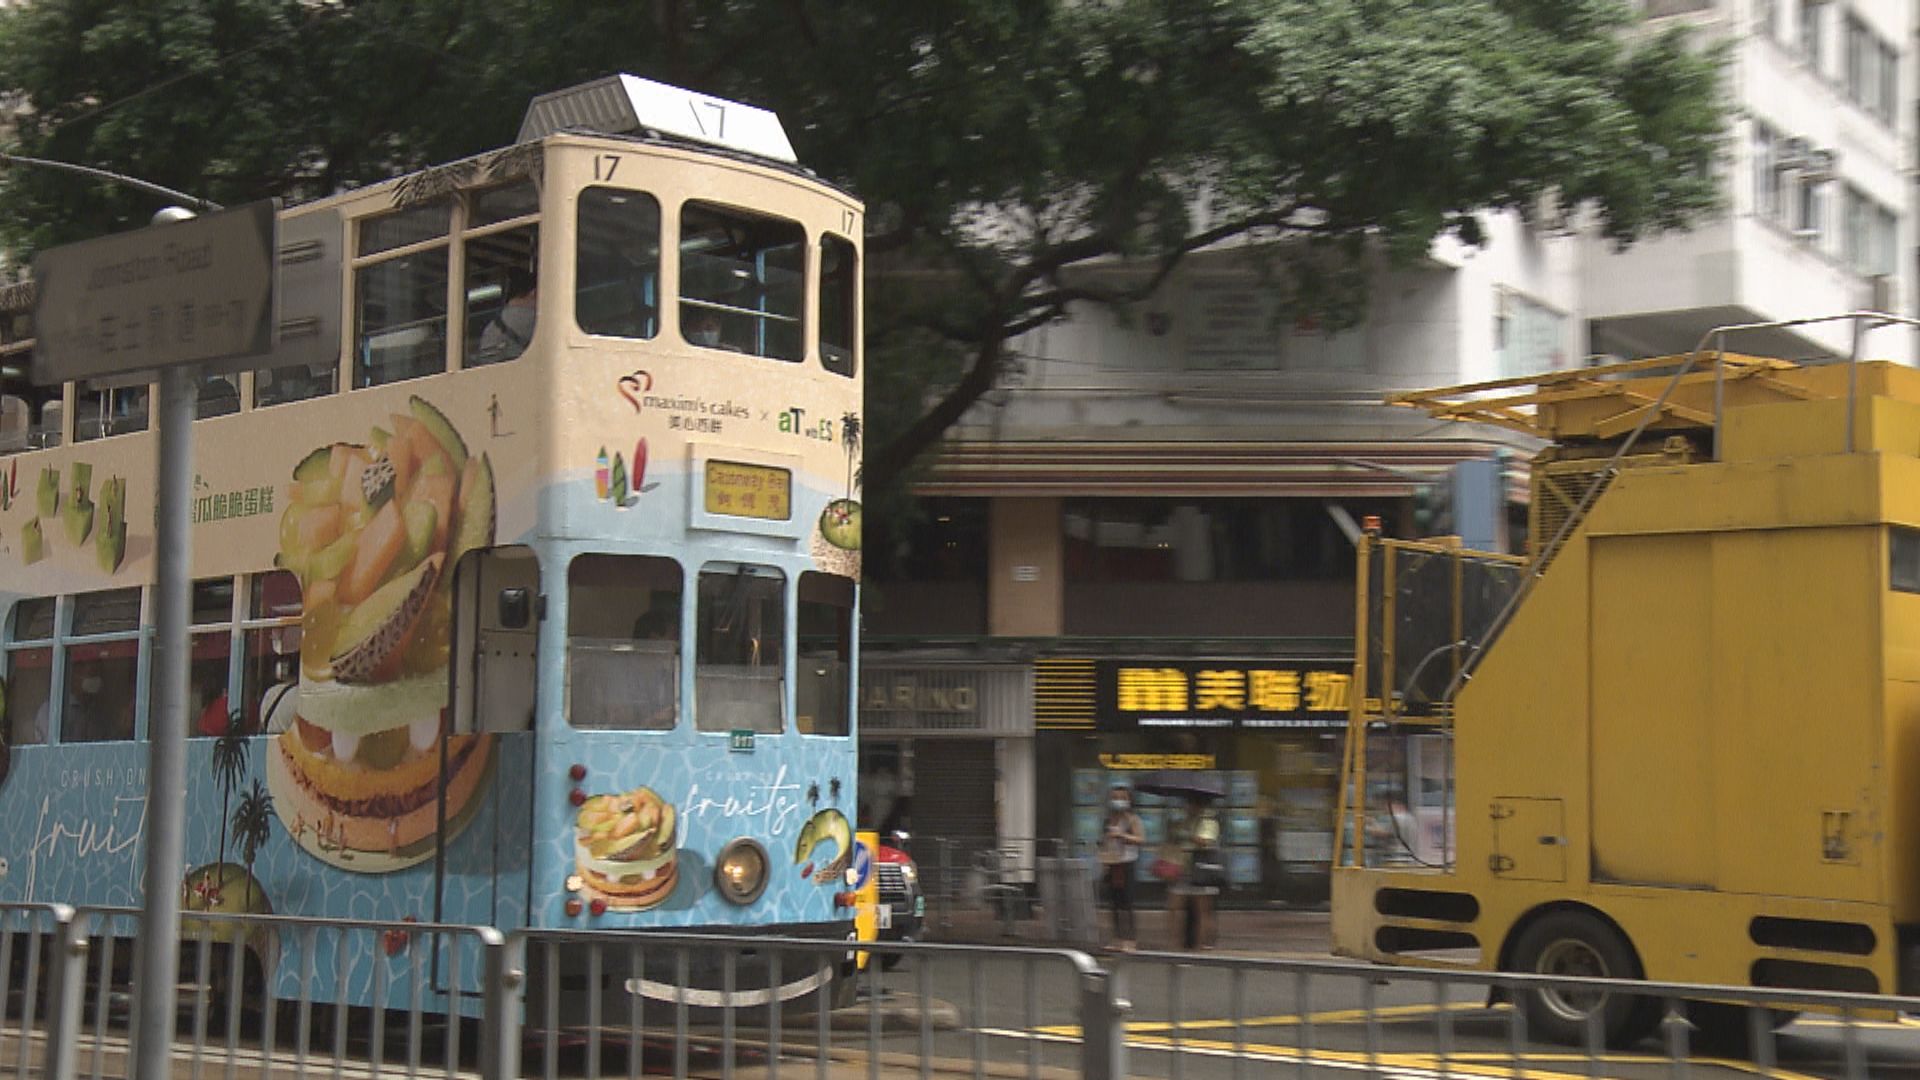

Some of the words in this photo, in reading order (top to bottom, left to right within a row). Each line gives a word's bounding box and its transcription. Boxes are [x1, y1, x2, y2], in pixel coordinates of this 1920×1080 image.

[688, 99, 725, 138] 17
[593, 154, 621, 181] 17
[842, 210, 856, 234] 17
[643, 394, 706, 413] maxim's
[709, 401, 750, 419] cakes
[60, 767, 114, 788] CRUSH
[126, 766, 146, 786] ON
[677, 764, 801, 850] fruits
[24, 789, 152, 915] fruit
